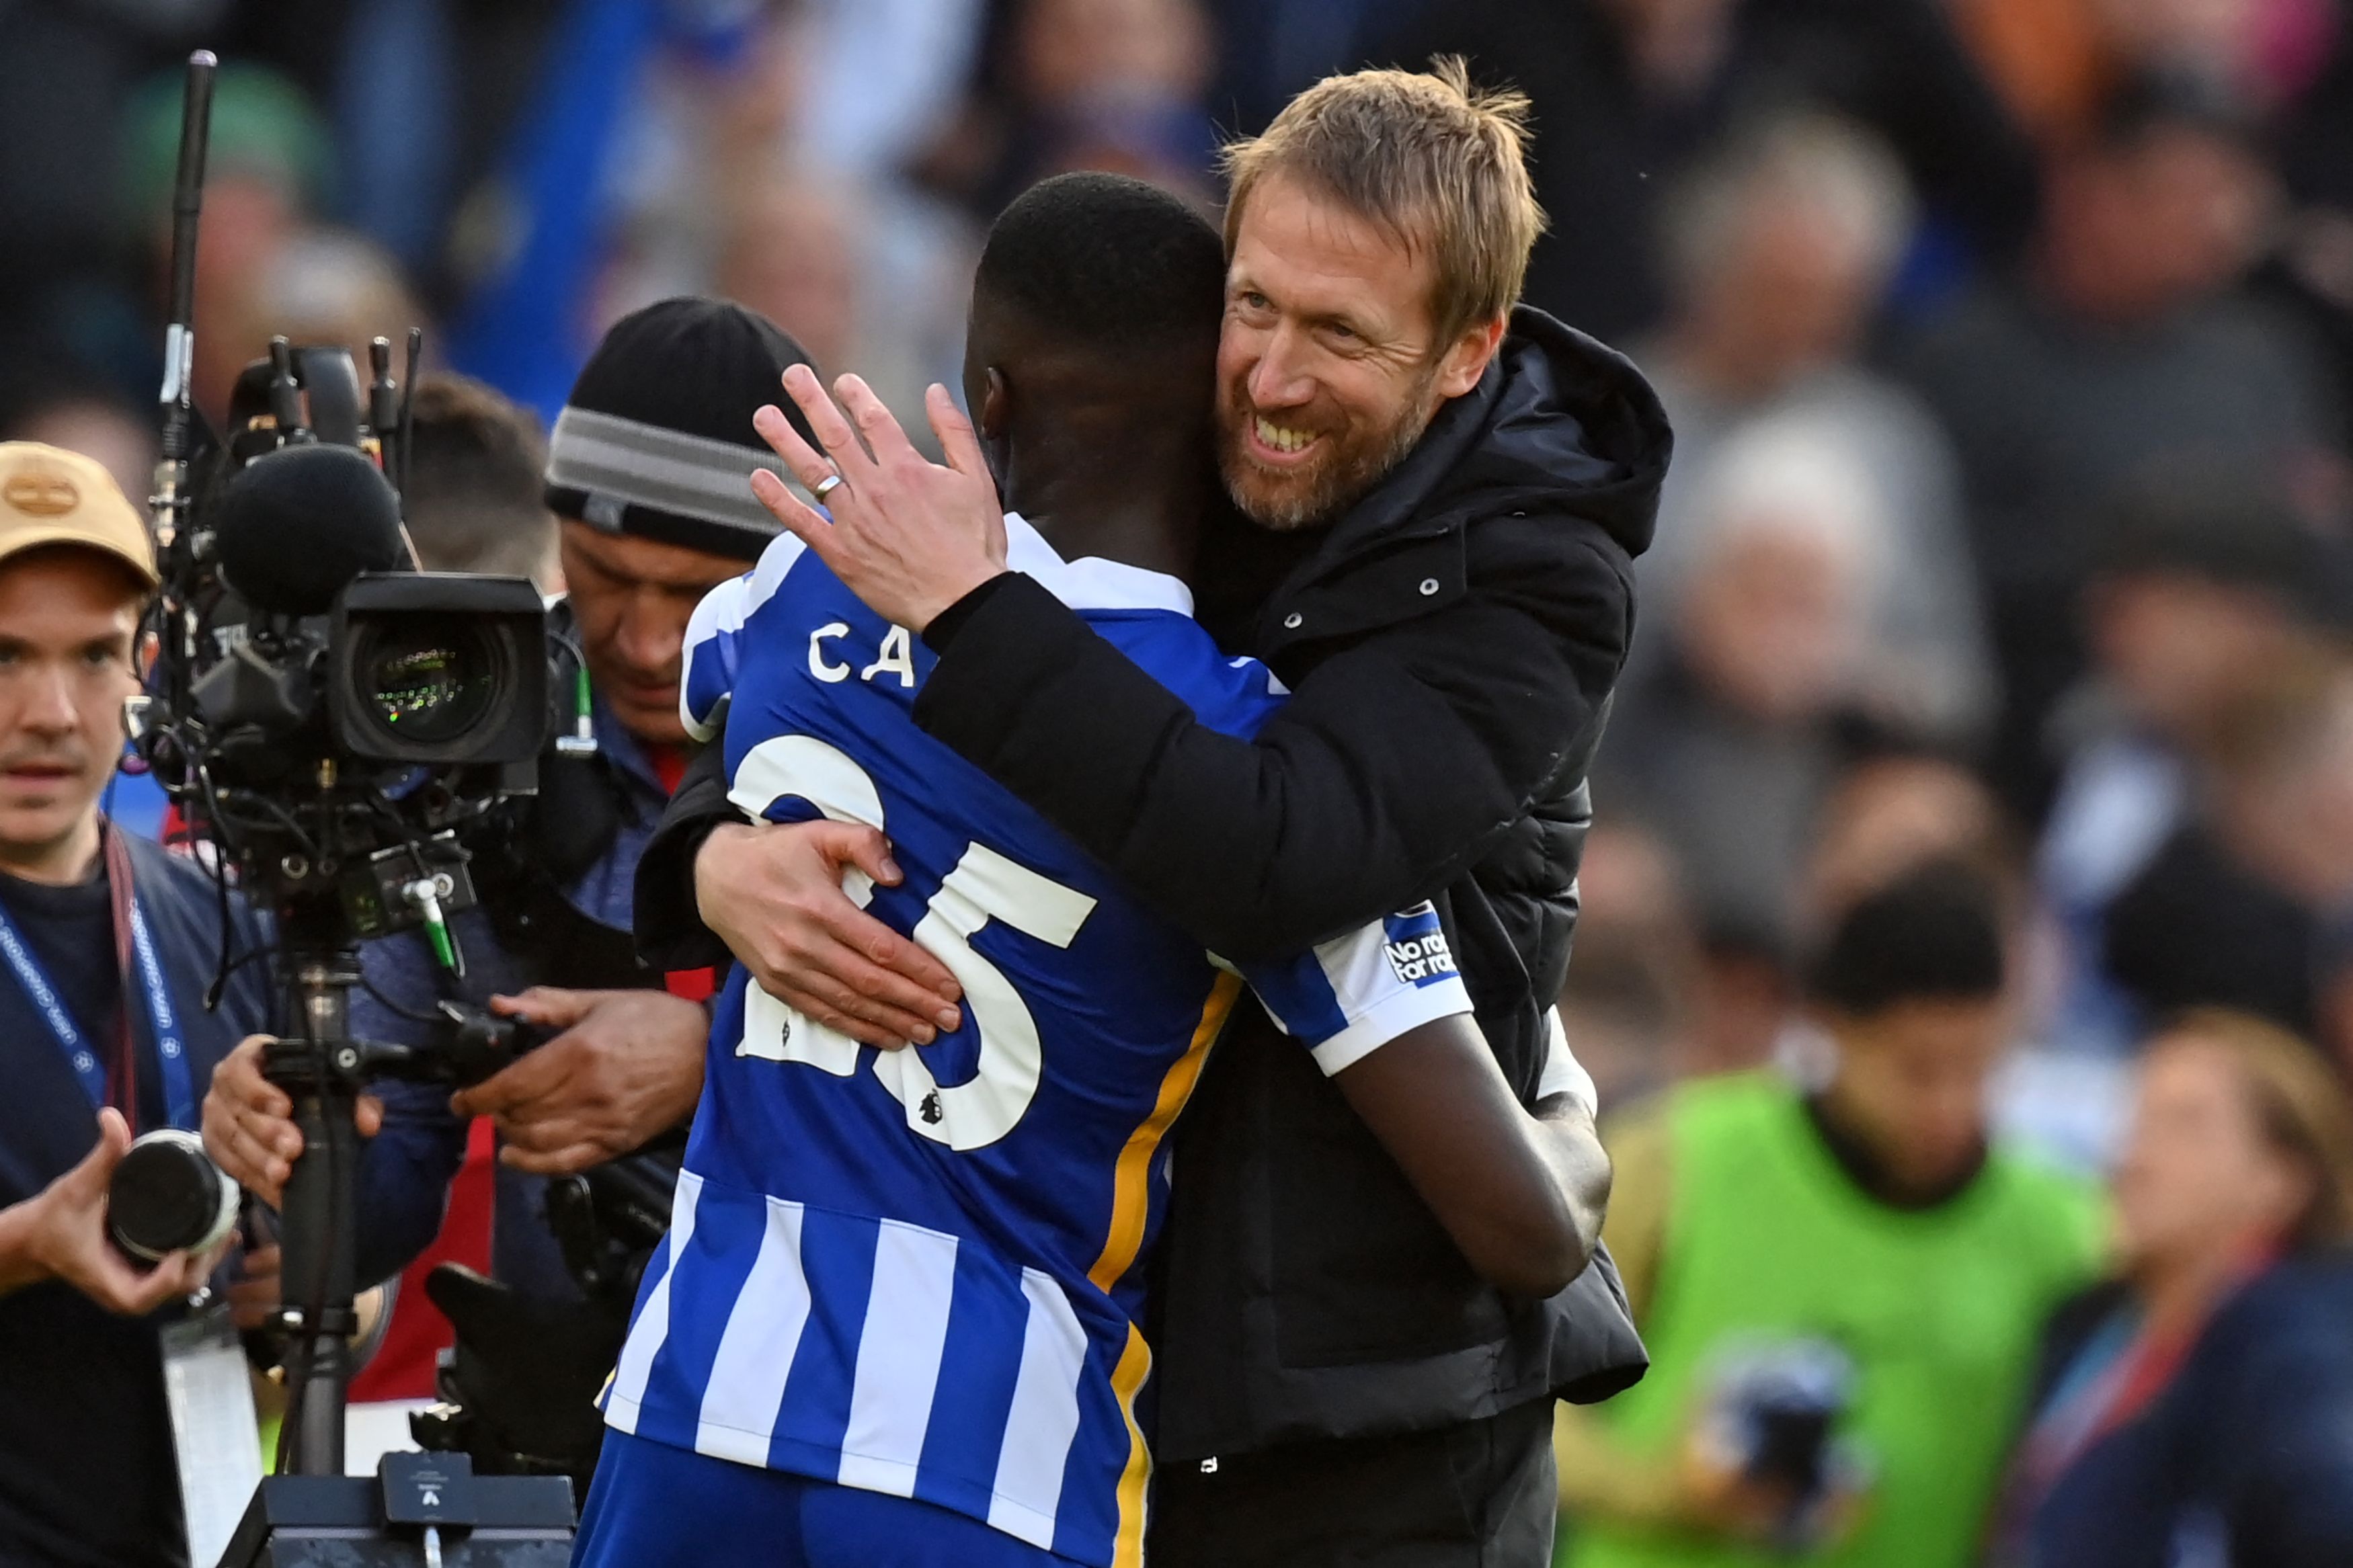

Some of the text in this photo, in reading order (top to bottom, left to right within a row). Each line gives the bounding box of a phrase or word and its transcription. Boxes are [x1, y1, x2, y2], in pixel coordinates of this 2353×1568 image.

[809, 622, 913, 687] CA
[1384, 933, 1449, 966] No ro
